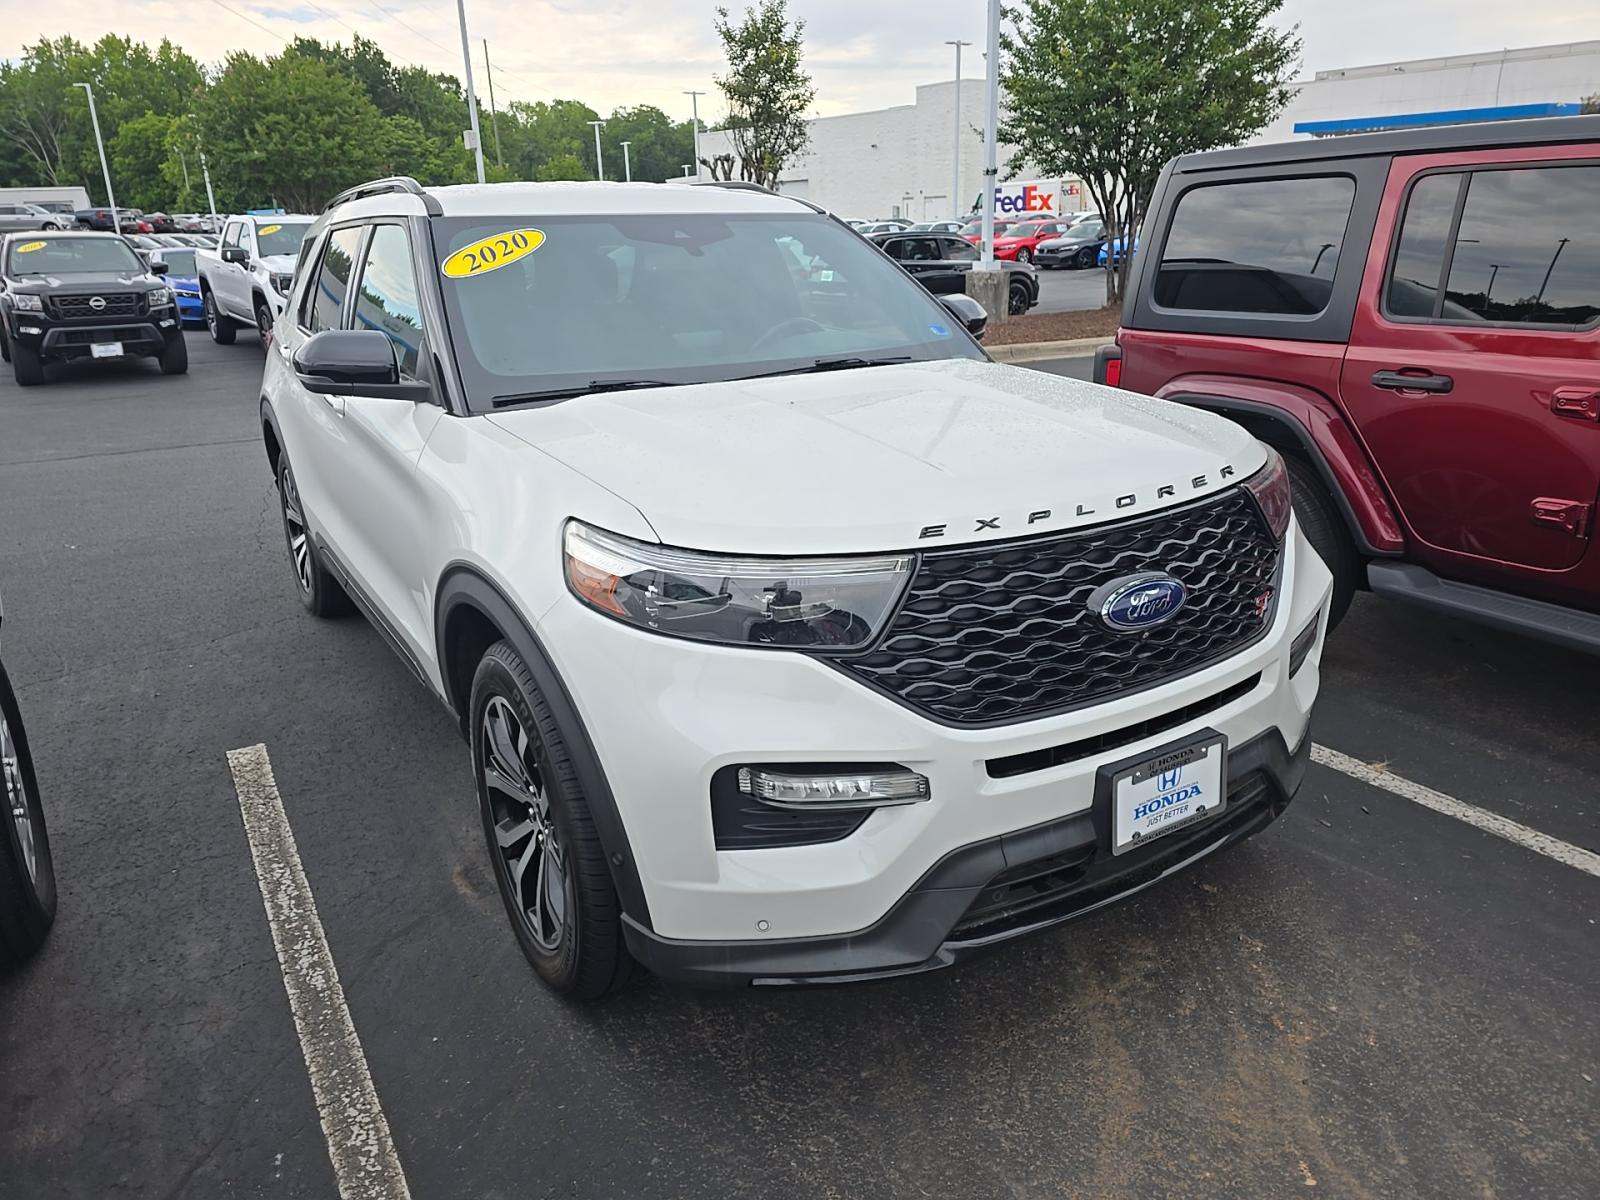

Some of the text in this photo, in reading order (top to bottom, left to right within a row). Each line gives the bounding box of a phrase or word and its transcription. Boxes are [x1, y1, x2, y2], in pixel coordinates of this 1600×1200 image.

[995, 185, 1053, 213] FedEx
[462, 232, 529, 272] 2020
[918, 464, 1235, 539] EXPLORER
[1126, 588, 1173, 620] Ford
[1133, 784, 1203, 821] HONDA
[1146, 804, 1189, 828] JUST BETTER
